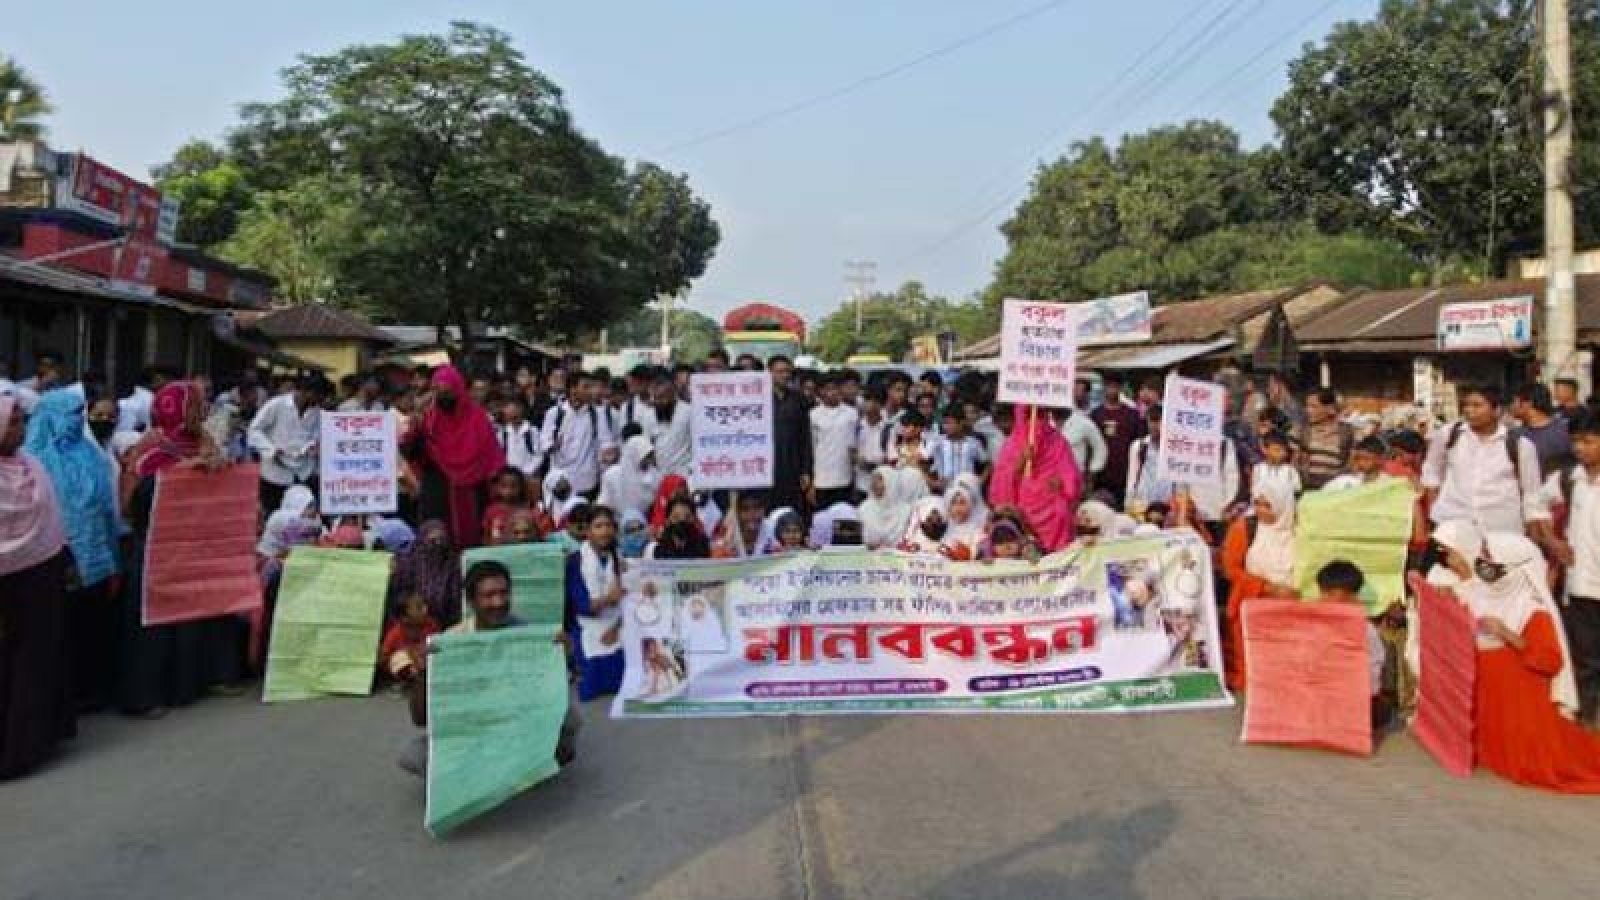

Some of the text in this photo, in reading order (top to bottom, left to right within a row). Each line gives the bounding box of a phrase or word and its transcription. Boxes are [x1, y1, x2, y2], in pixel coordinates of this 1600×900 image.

[1021, 305, 1066, 325] বকুল
[1181, 385, 1213, 406] বকুল
[704, 403, 764, 425] বকুলের
[332, 415, 385, 436] বকুল
[740, 455, 768, 476] চাই
[743, 617, 1097, 664] মানববন্ধন
